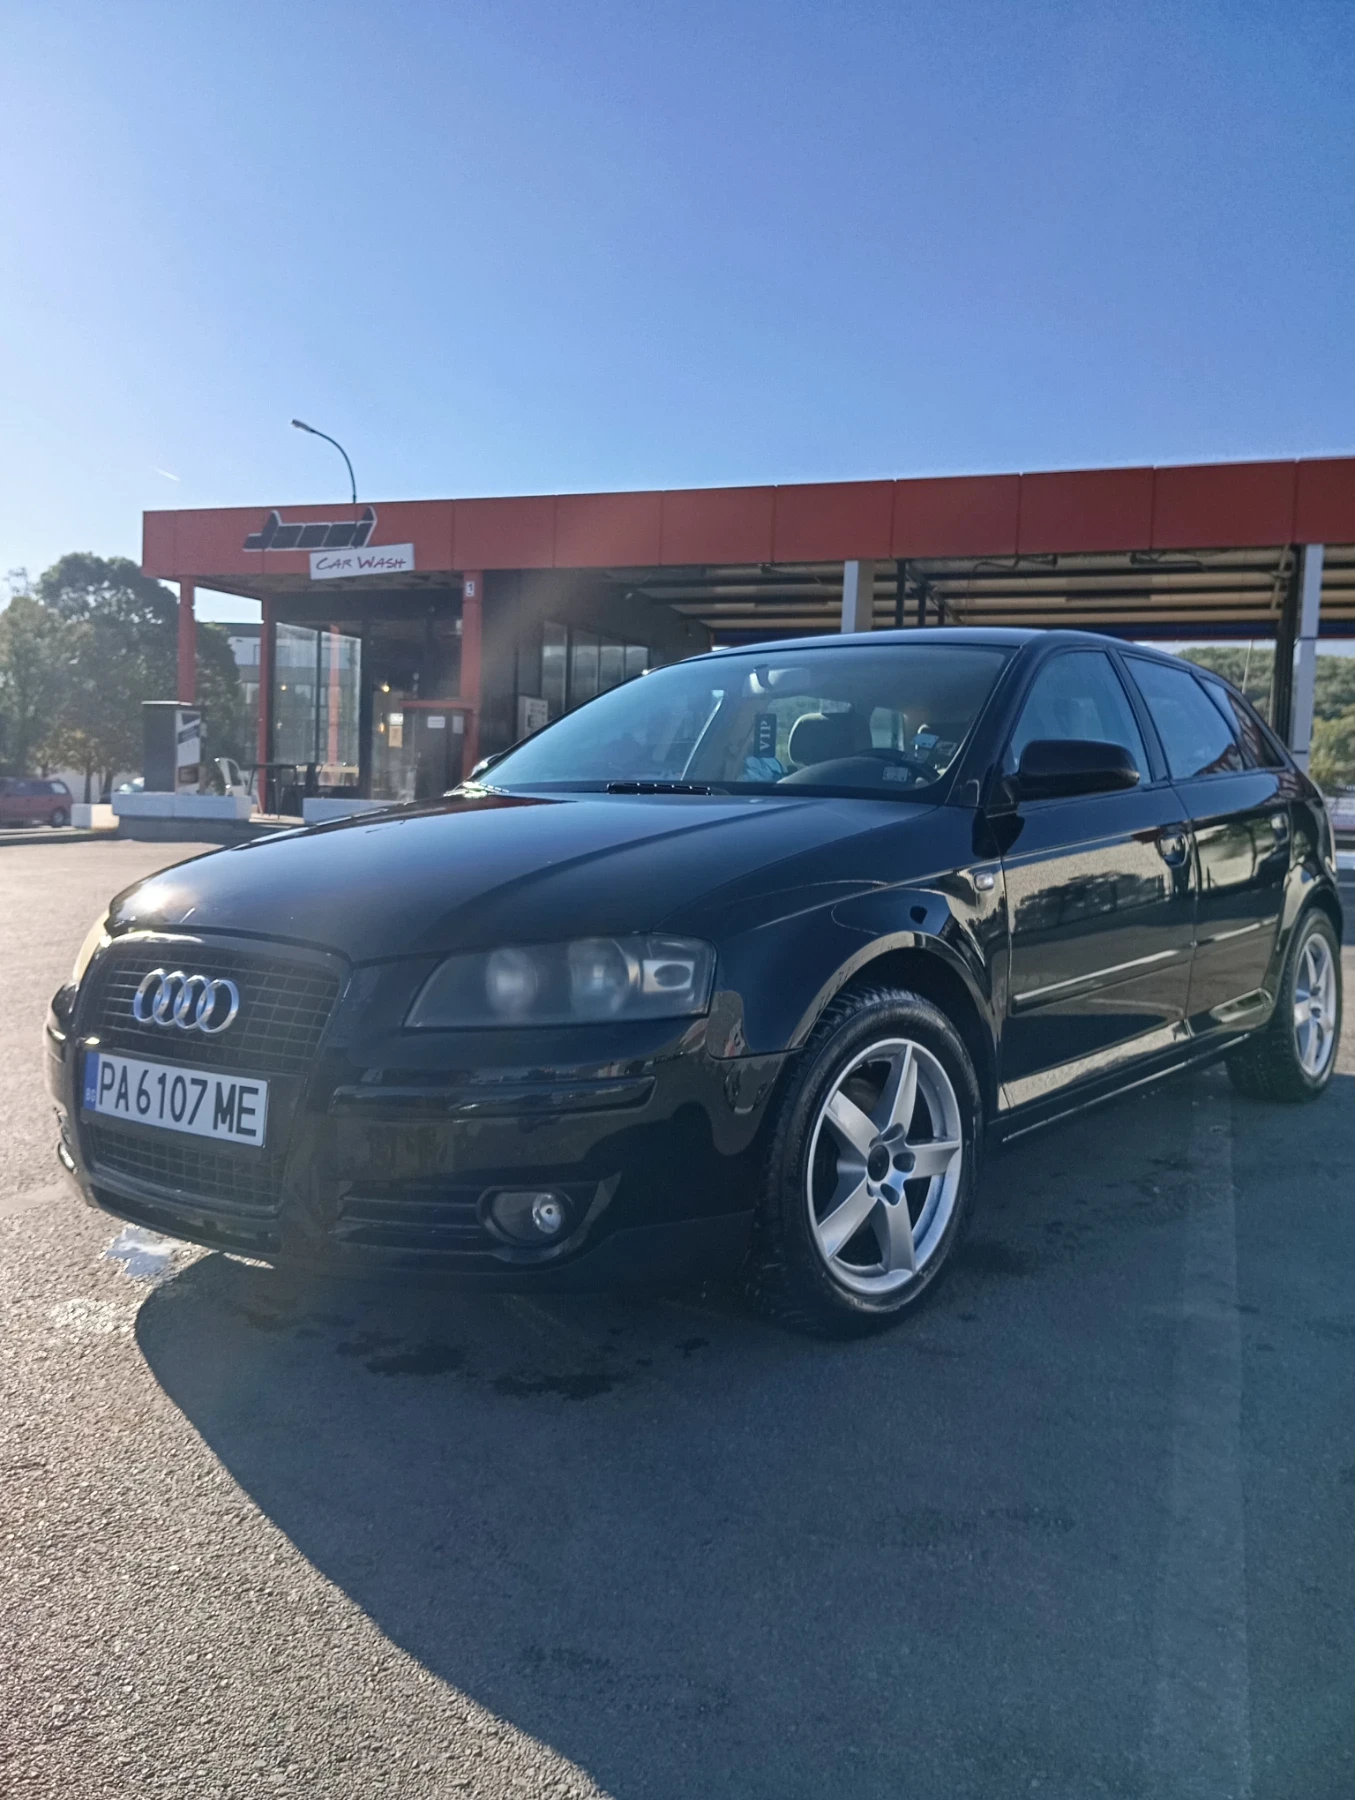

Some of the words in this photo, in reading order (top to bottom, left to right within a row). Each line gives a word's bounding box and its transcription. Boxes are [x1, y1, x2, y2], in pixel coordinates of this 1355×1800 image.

[316, 557, 352, 571] CAR
[357, 556, 406, 569] WASH
[760, 720, 770, 750] VIP
